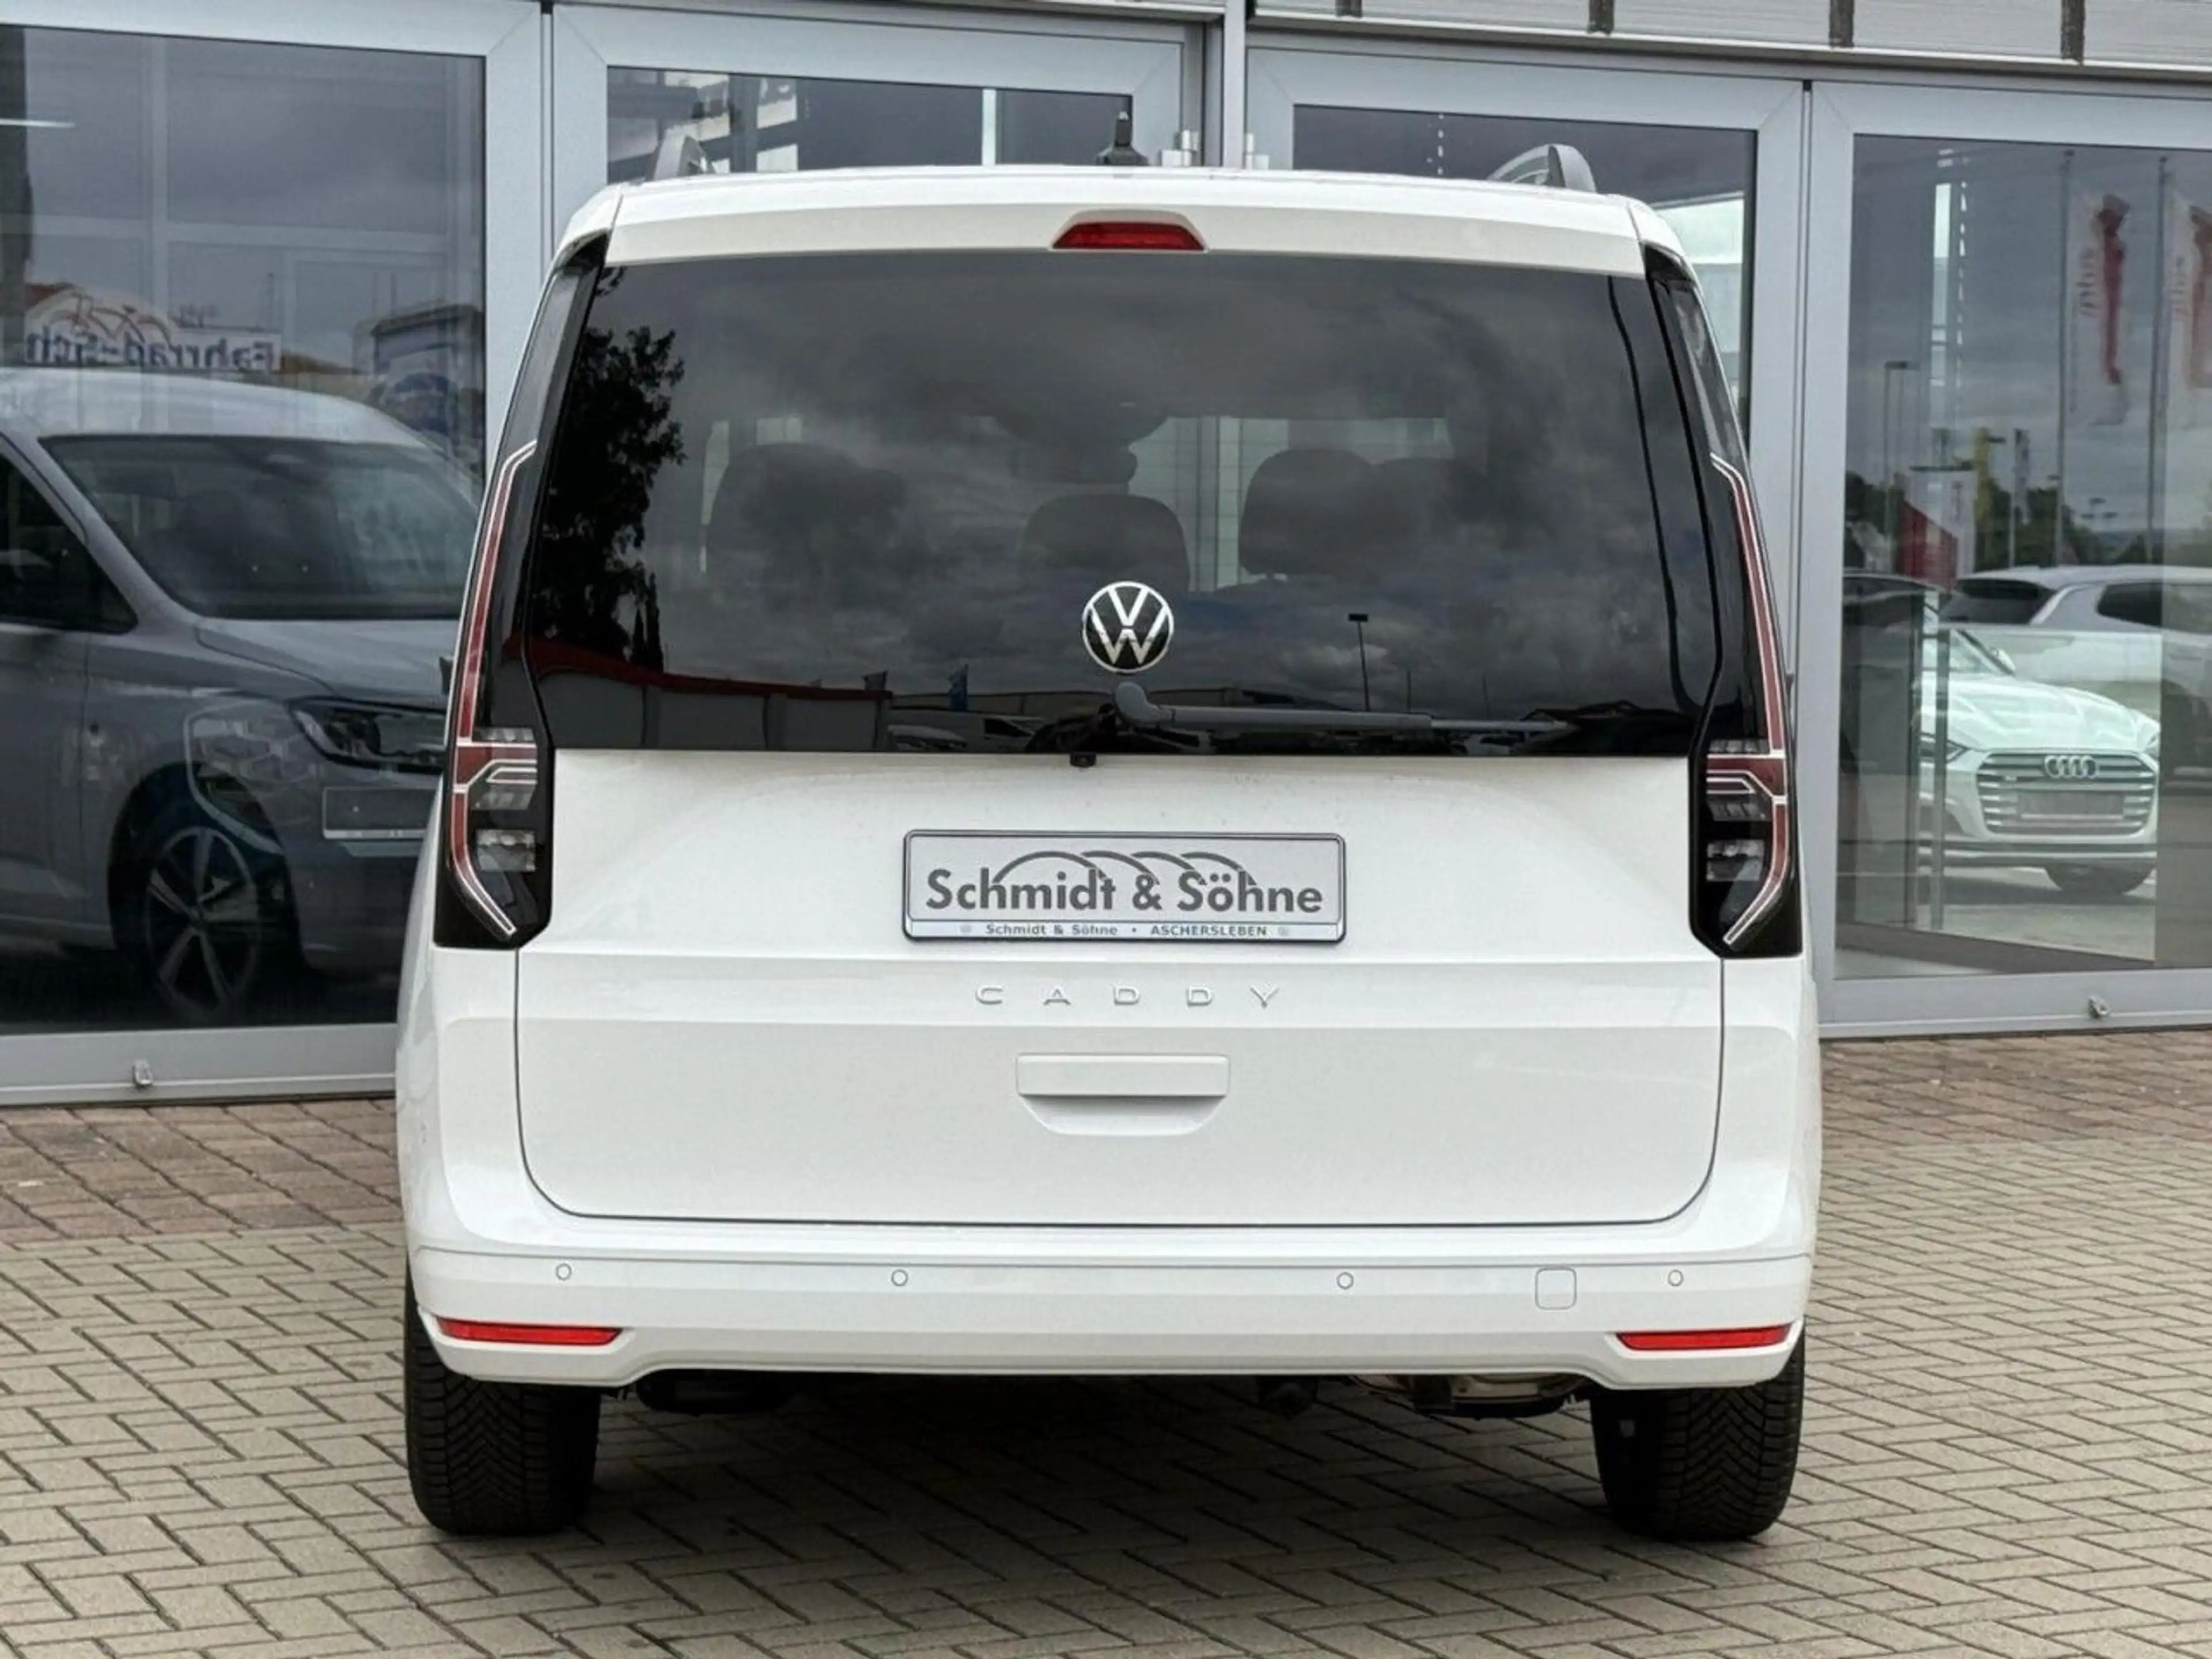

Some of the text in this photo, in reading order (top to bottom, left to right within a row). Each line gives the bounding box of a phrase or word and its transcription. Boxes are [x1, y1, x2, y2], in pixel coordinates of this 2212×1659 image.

[926, 866, 1323, 913] Schmidt & Söhne
[986, 923, 1267, 937] Schmidt & Söhne ASCHERSLEBEN
[975, 983, 1279, 1009] CADDY
